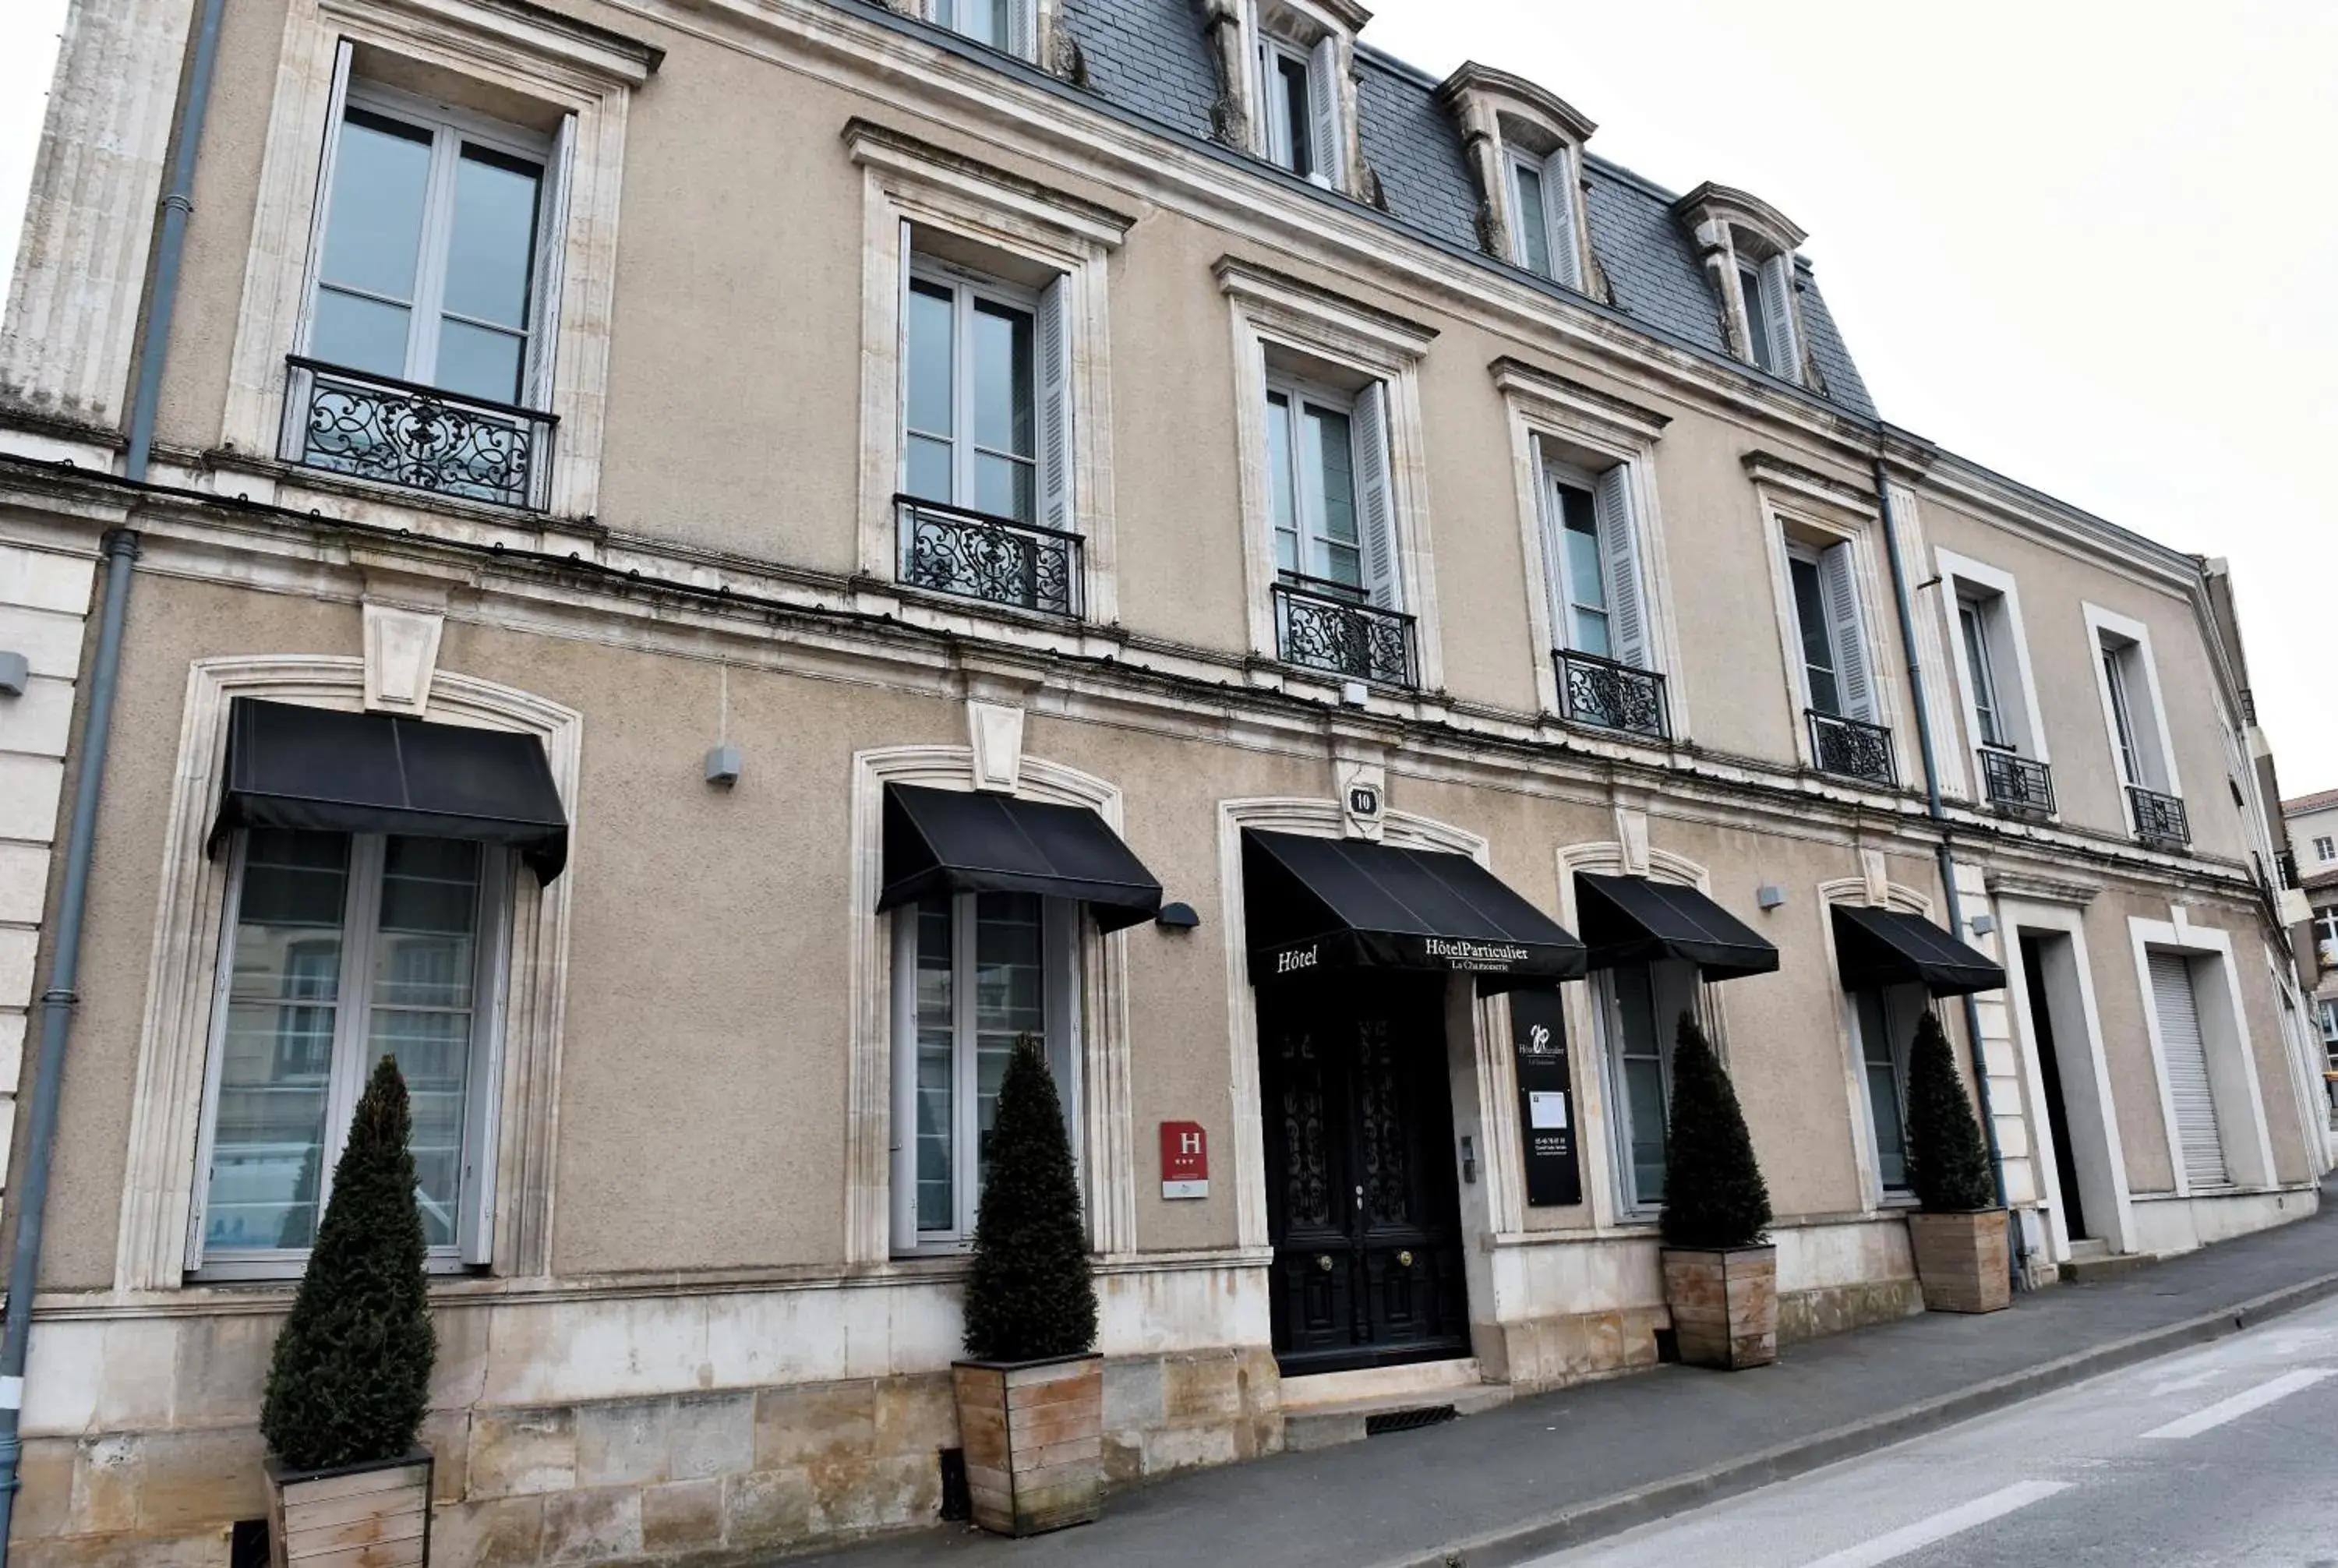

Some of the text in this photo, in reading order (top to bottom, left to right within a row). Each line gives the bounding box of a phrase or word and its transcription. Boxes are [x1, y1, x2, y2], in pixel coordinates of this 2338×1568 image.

[1357, 793, 1371, 810] 10
[1277, 944, 1318, 973] Hôtel
[1451, 959, 1462, 969] La
[1179, 1132, 1203, 1154] H
